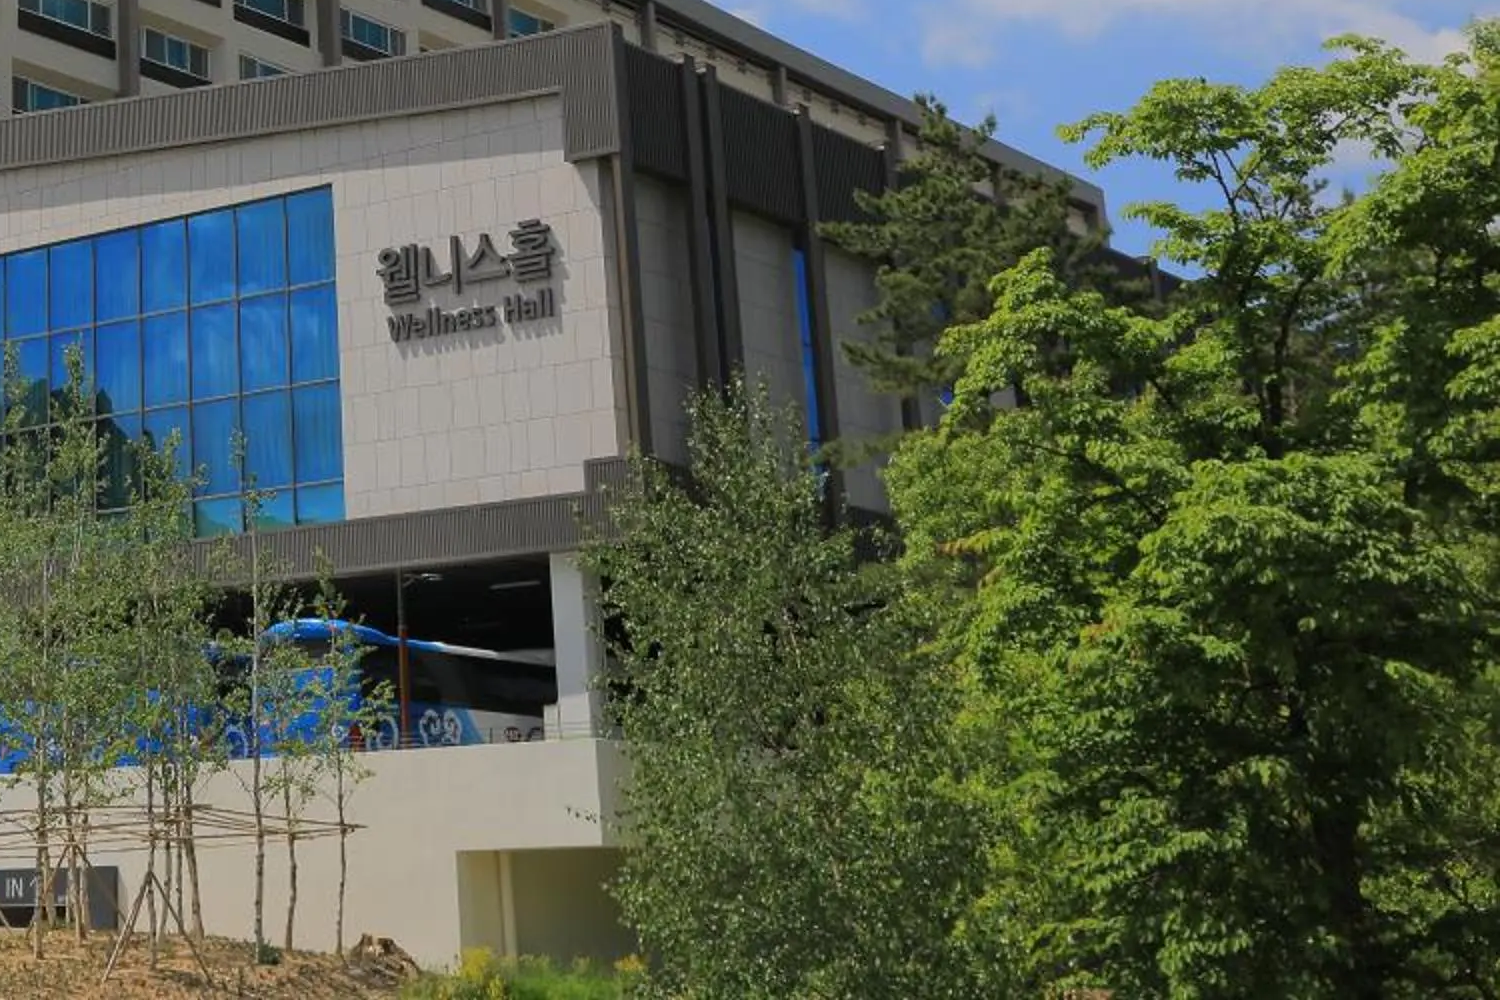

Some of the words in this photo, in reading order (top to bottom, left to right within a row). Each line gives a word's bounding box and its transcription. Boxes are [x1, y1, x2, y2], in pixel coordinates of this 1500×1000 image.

[376, 219, 555, 306] 웰니스홀
[387, 306, 496, 343] Wellness
[504, 289, 554, 324] Hall
[5, 878, 23, 899] IN
